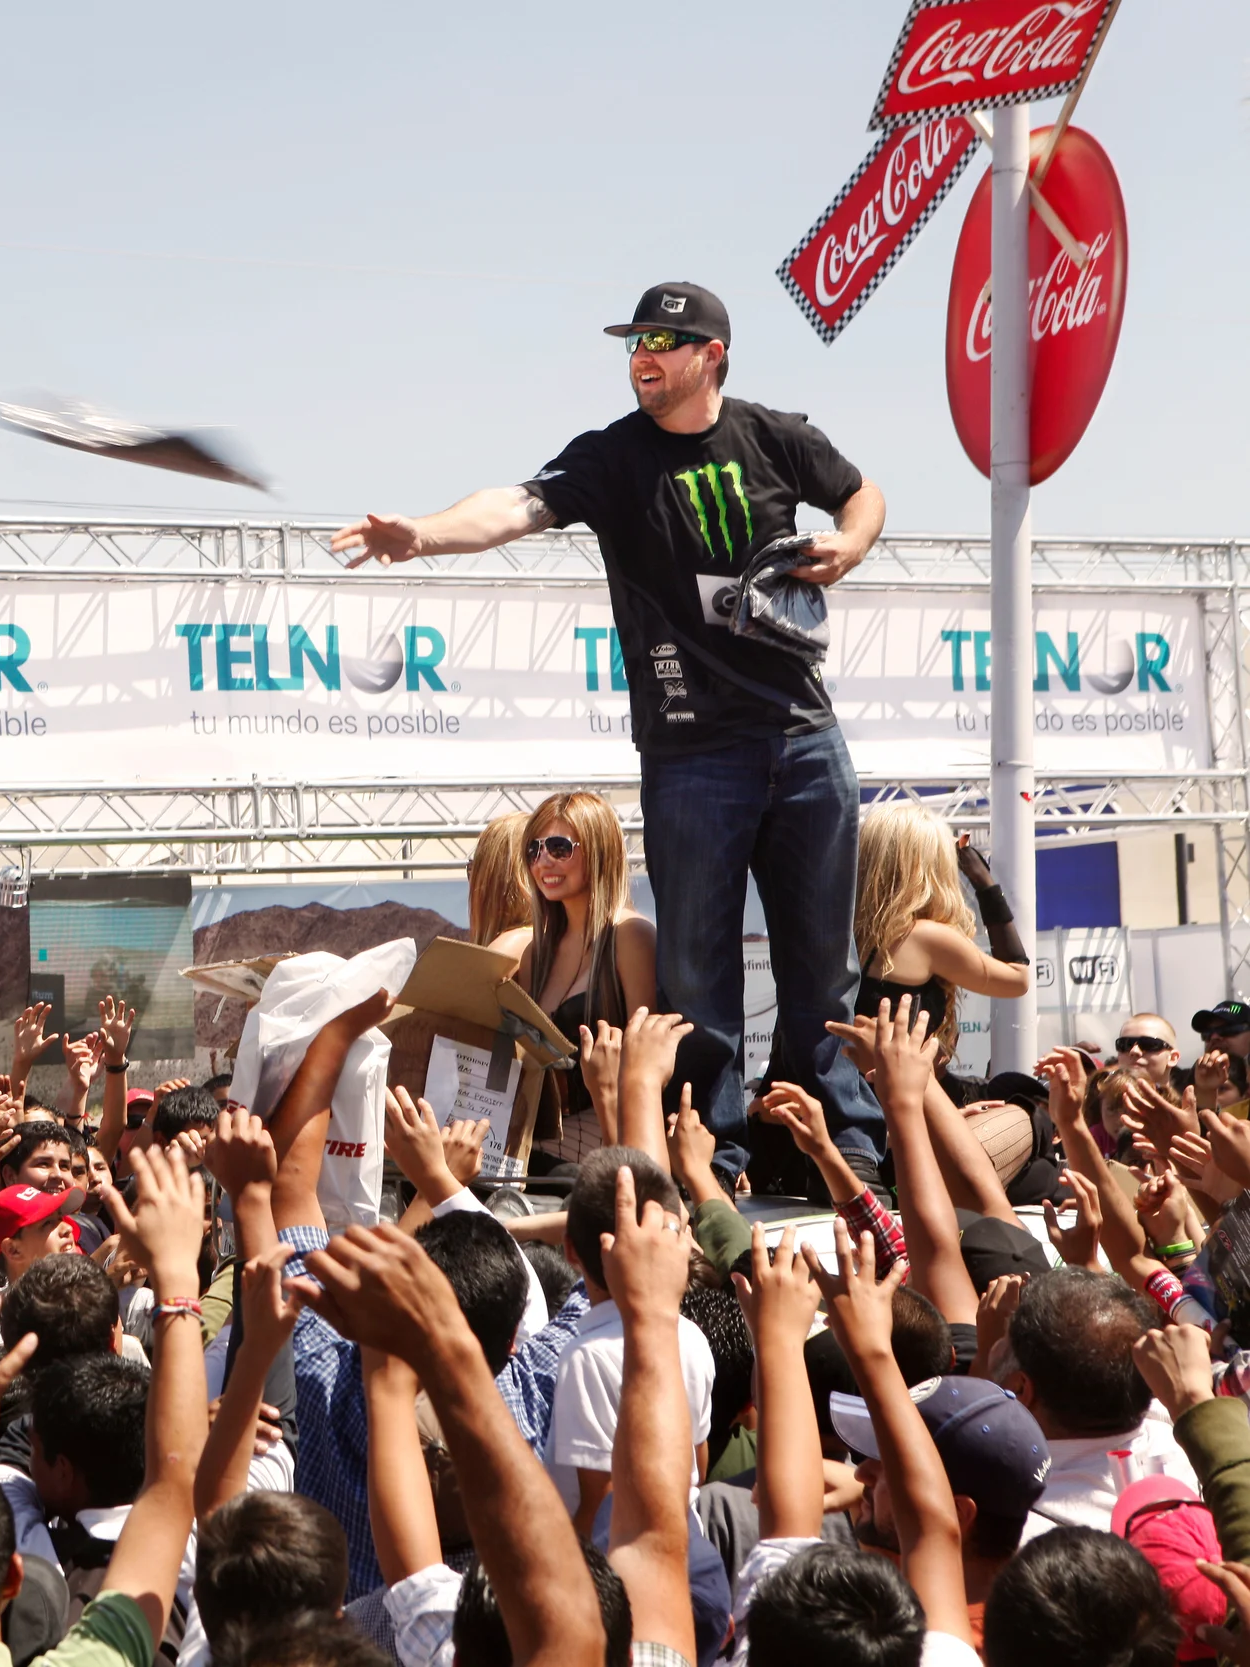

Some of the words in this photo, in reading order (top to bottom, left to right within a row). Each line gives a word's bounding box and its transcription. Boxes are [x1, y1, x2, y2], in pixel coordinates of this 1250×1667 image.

[897, 0, 1097, 94] Coca-Cola
[814, 117, 953, 308] Coca-Cola
[940, 630, 1171, 695] TENOR
[190, 710, 217, 735] tu
[228, 708, 320, 734] mundo
[328, 715, 358, 735] es
[367, 708, 460, 740] posible
[588, 709, 612, 733] tu
[955, 708, 976, 732] tu
[1071, 714, 1098, 732] es
[1105, 708, 1184, 736] posible
[489, 1140, 502, 1151] 176
